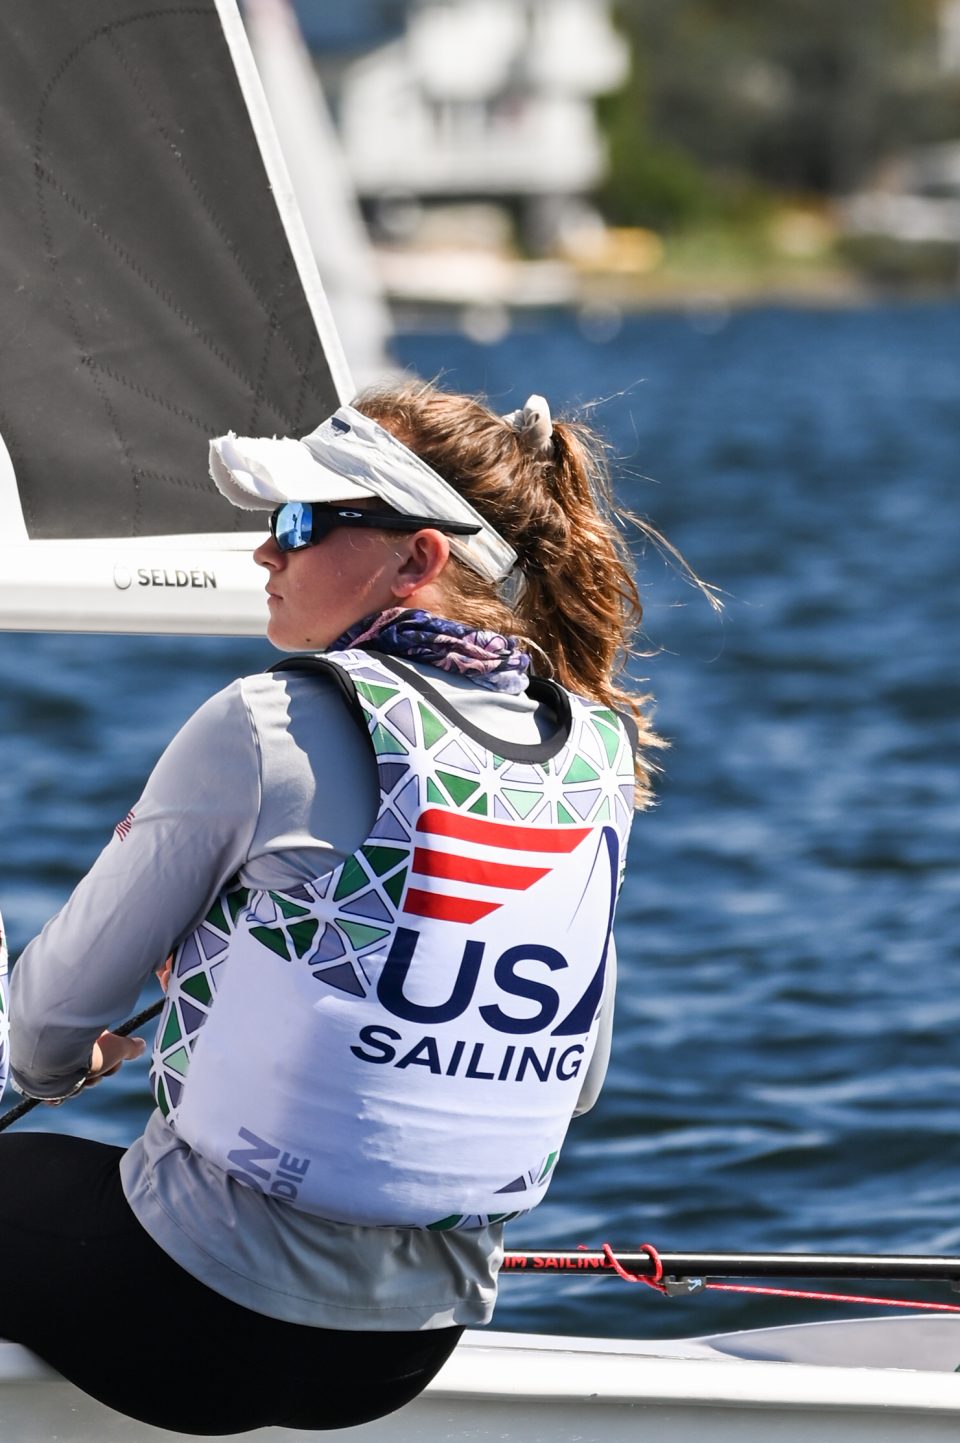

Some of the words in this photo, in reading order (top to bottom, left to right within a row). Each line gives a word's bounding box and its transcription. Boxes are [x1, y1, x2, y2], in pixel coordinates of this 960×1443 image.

[350, 1024, 585, 1082] SAILING
[270, 1152, 311, 1204] DIE
[500, 1256, 527, 1269] IM
